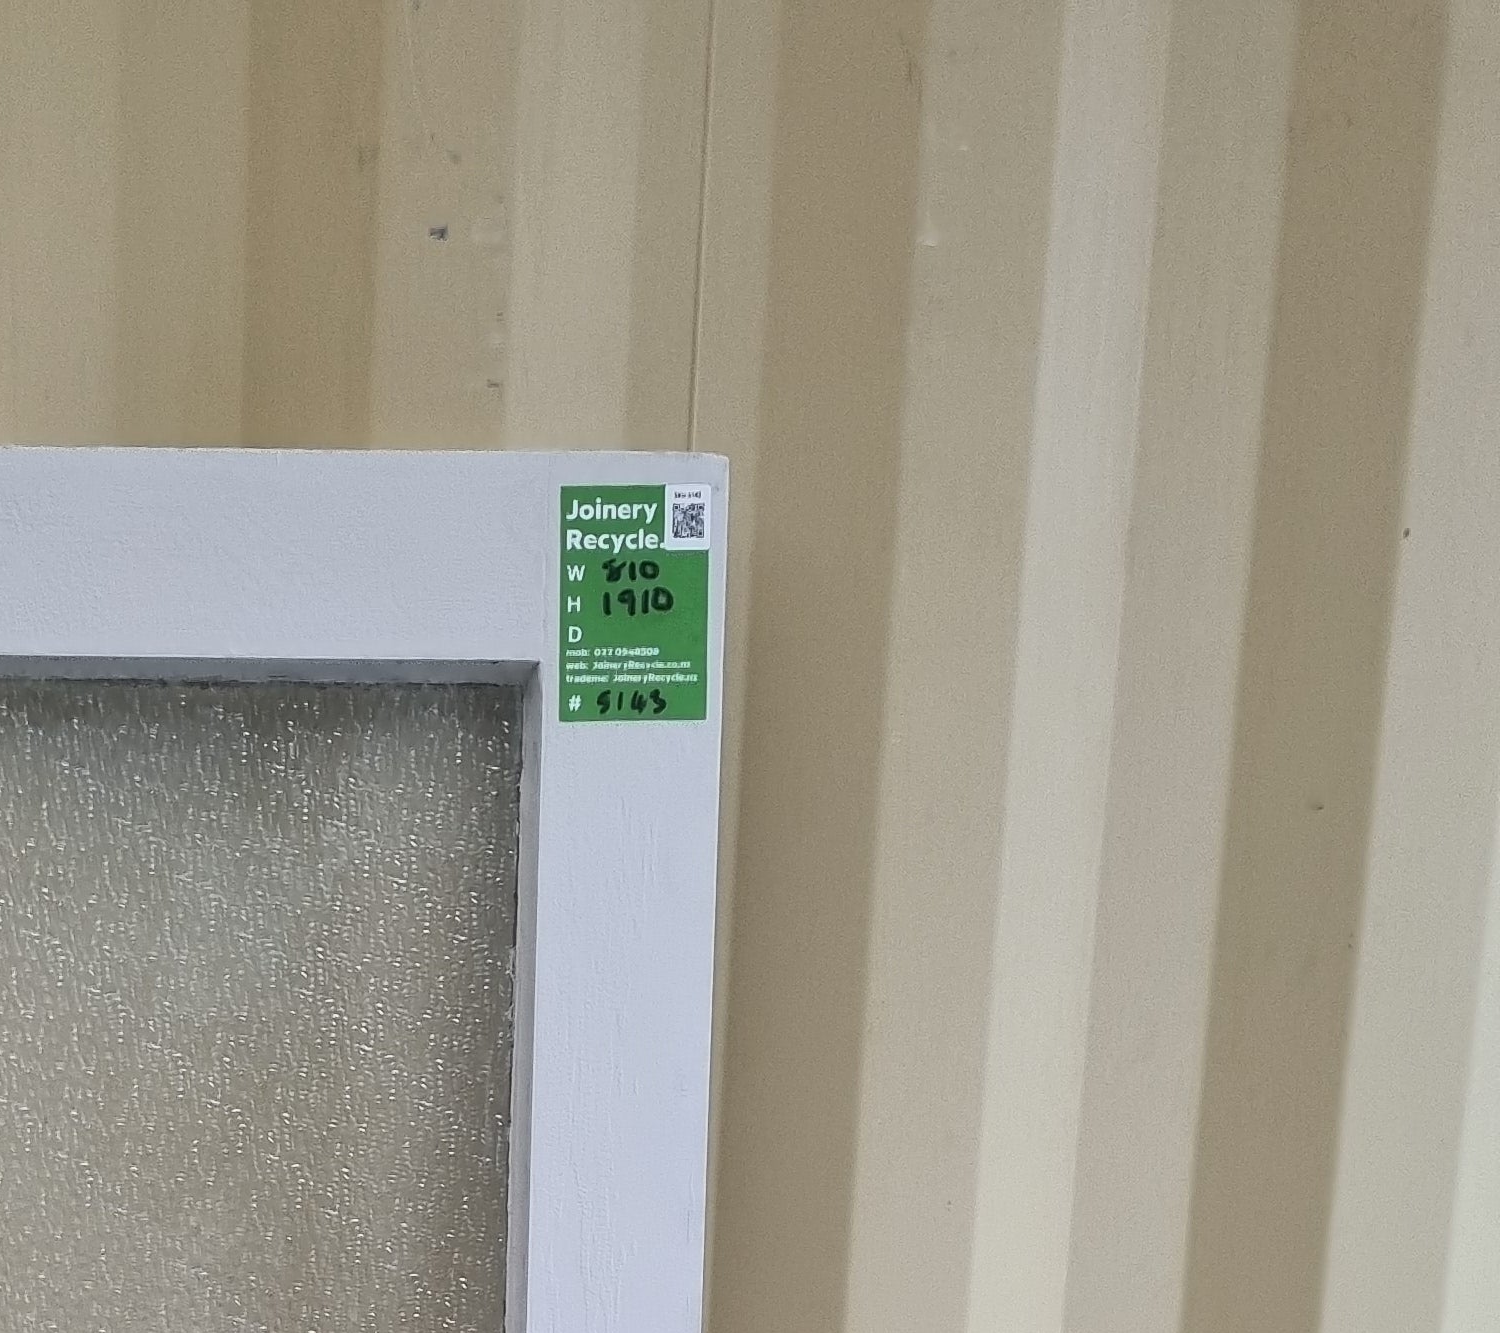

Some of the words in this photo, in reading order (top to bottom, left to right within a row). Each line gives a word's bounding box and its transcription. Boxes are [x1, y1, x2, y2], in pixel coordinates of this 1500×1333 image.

[566, 497, 658, 524] Joinery
[566, 565, 586, 582] W
[602, 558, 660, 582] 810
[567, 596, 581, 613] H
[603, 587, 674, 616] 1910
[568, 626, 583, 643] D
[568, 694, 582, 712] #
[596, 688, 667, 715] 5143
